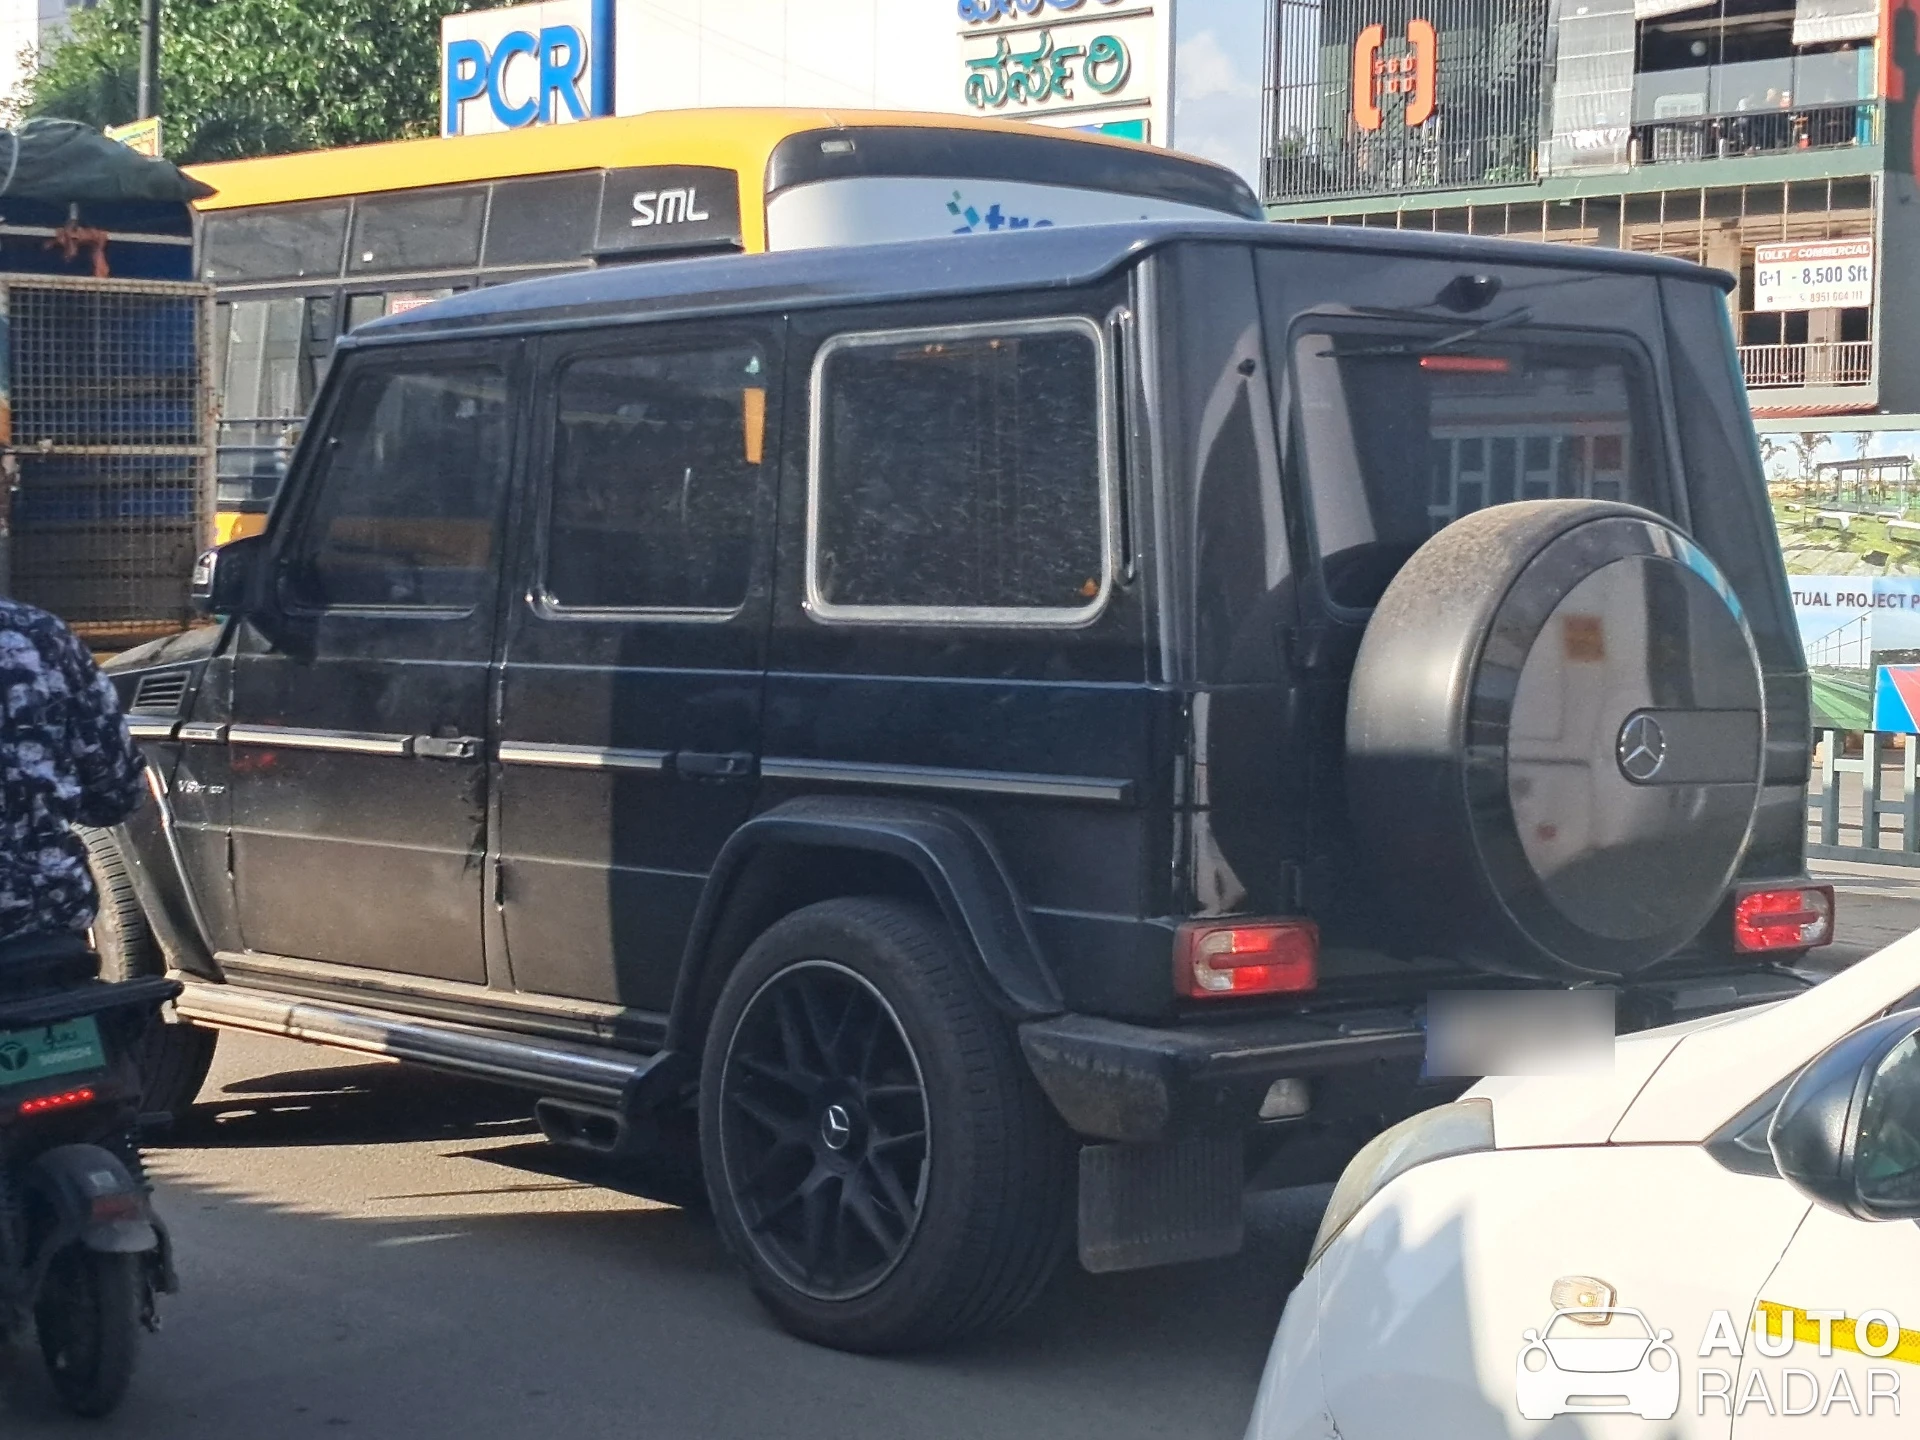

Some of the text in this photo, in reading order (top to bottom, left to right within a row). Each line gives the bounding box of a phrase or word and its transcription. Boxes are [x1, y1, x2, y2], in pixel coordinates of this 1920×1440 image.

[447, 24, 591, 136] PCR
[631, 187, 709, 227] SML
[1797, 244, 1869, 259] COMMERCIAL
[1759, 270, 1781, 287] G+1
[1802, 266, 1843, 286] 8,500
[1848, 265, 1868, 282] Sft
[1837, 593, 1906, 608] PROJECT
